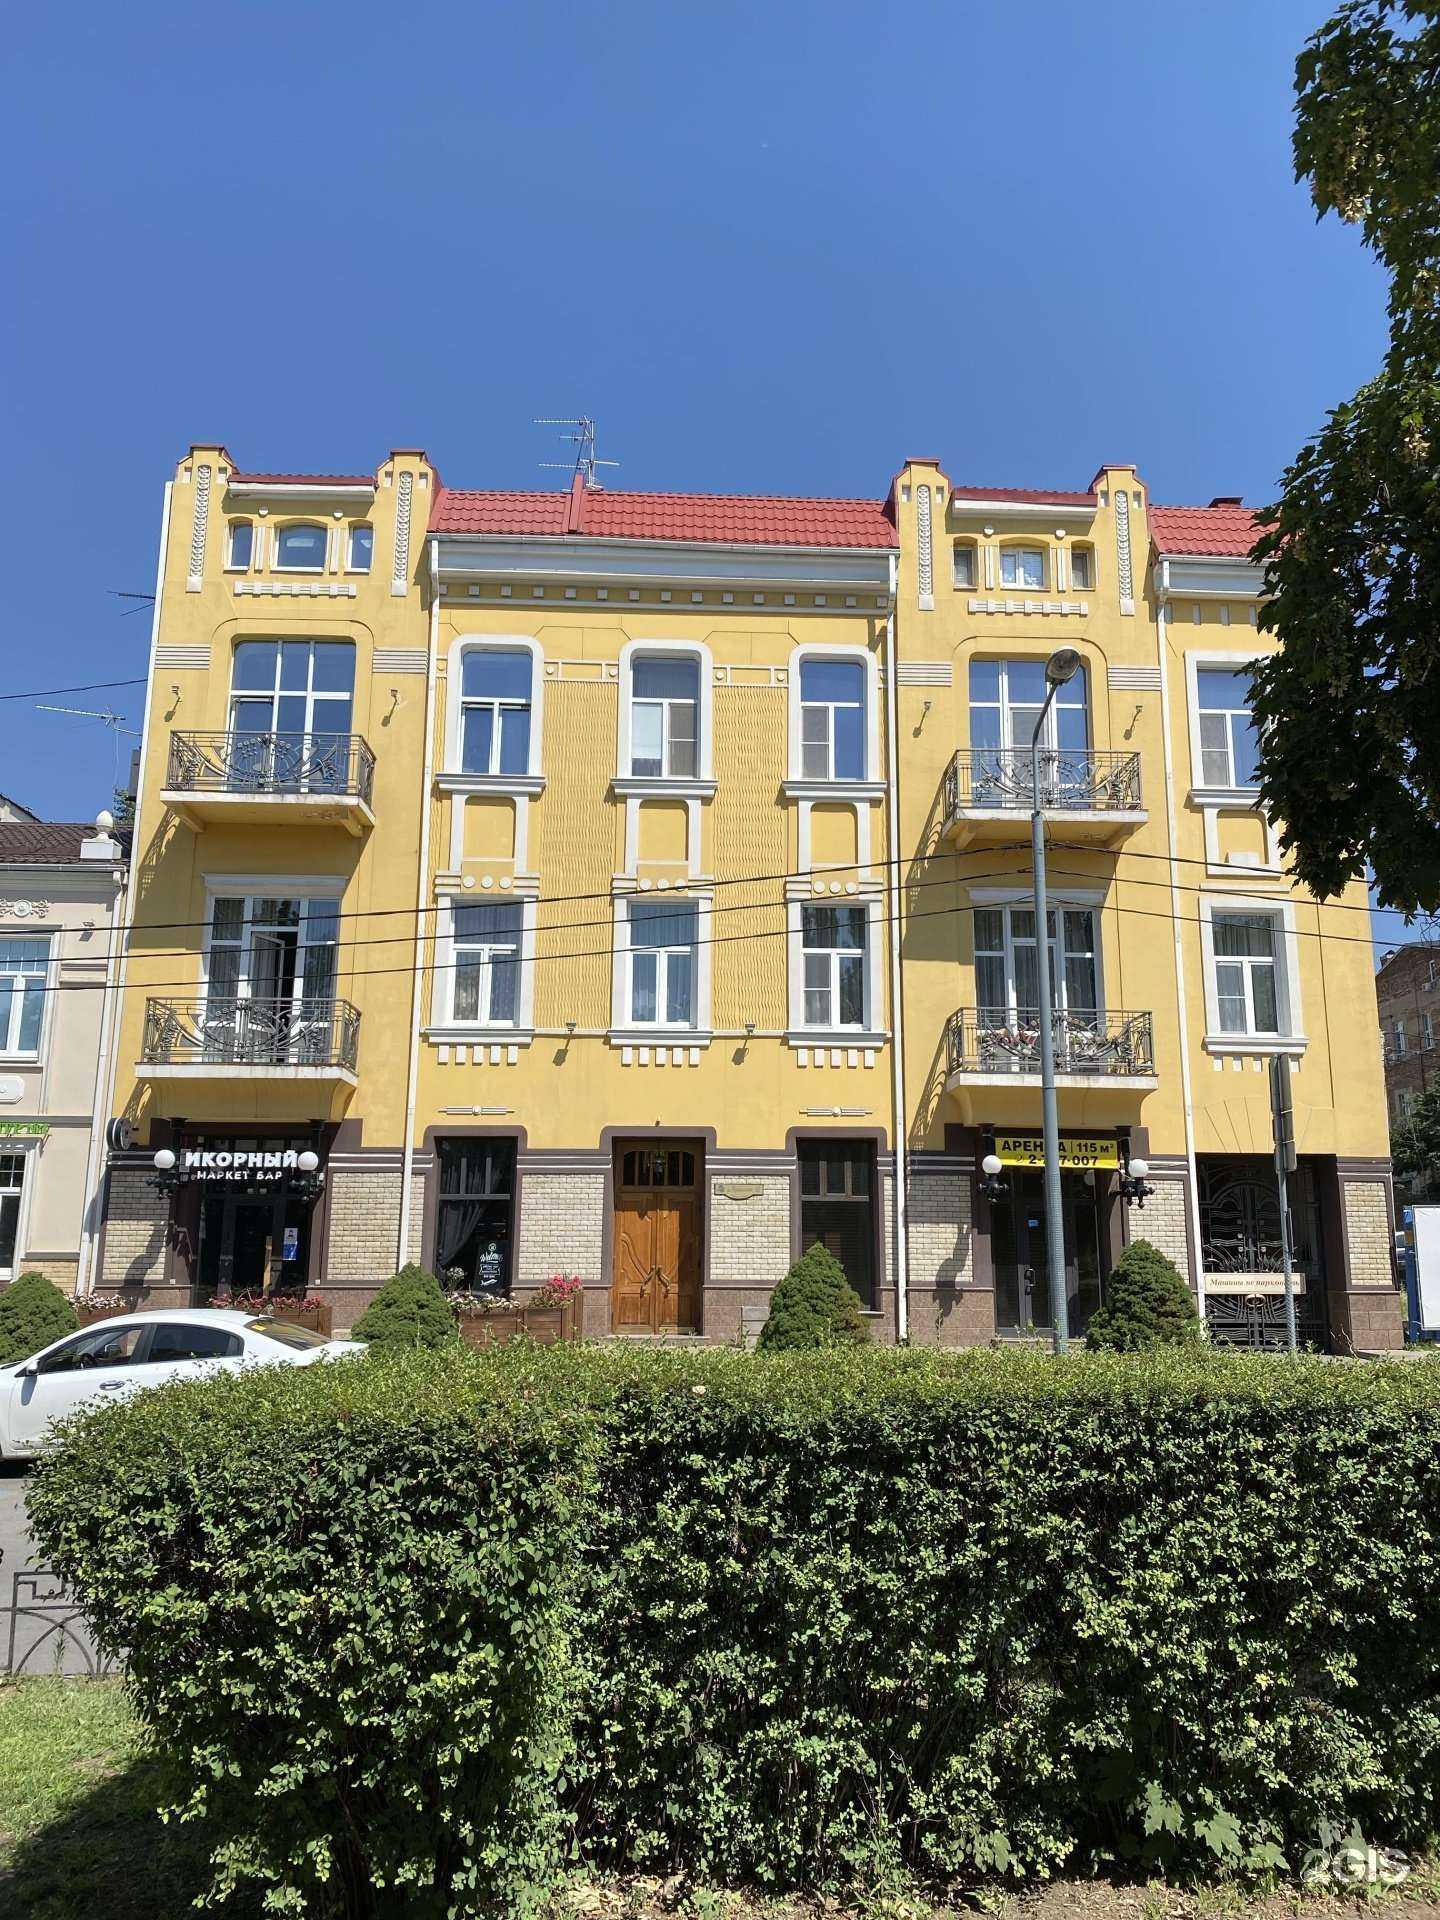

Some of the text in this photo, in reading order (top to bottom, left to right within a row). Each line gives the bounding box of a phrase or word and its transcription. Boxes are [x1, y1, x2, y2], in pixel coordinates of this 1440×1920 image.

[1002, 1140, 1067, 1153] АРЕНА
[1077, 1142, 1098, 1153] 115
[185, 1149, 298, 1168] ИКОРНЫЙ
[1028, 1154, 1099, 1166] 2-7-007
[197, 1170, 283, 1180] МАРКЕТ БАР
